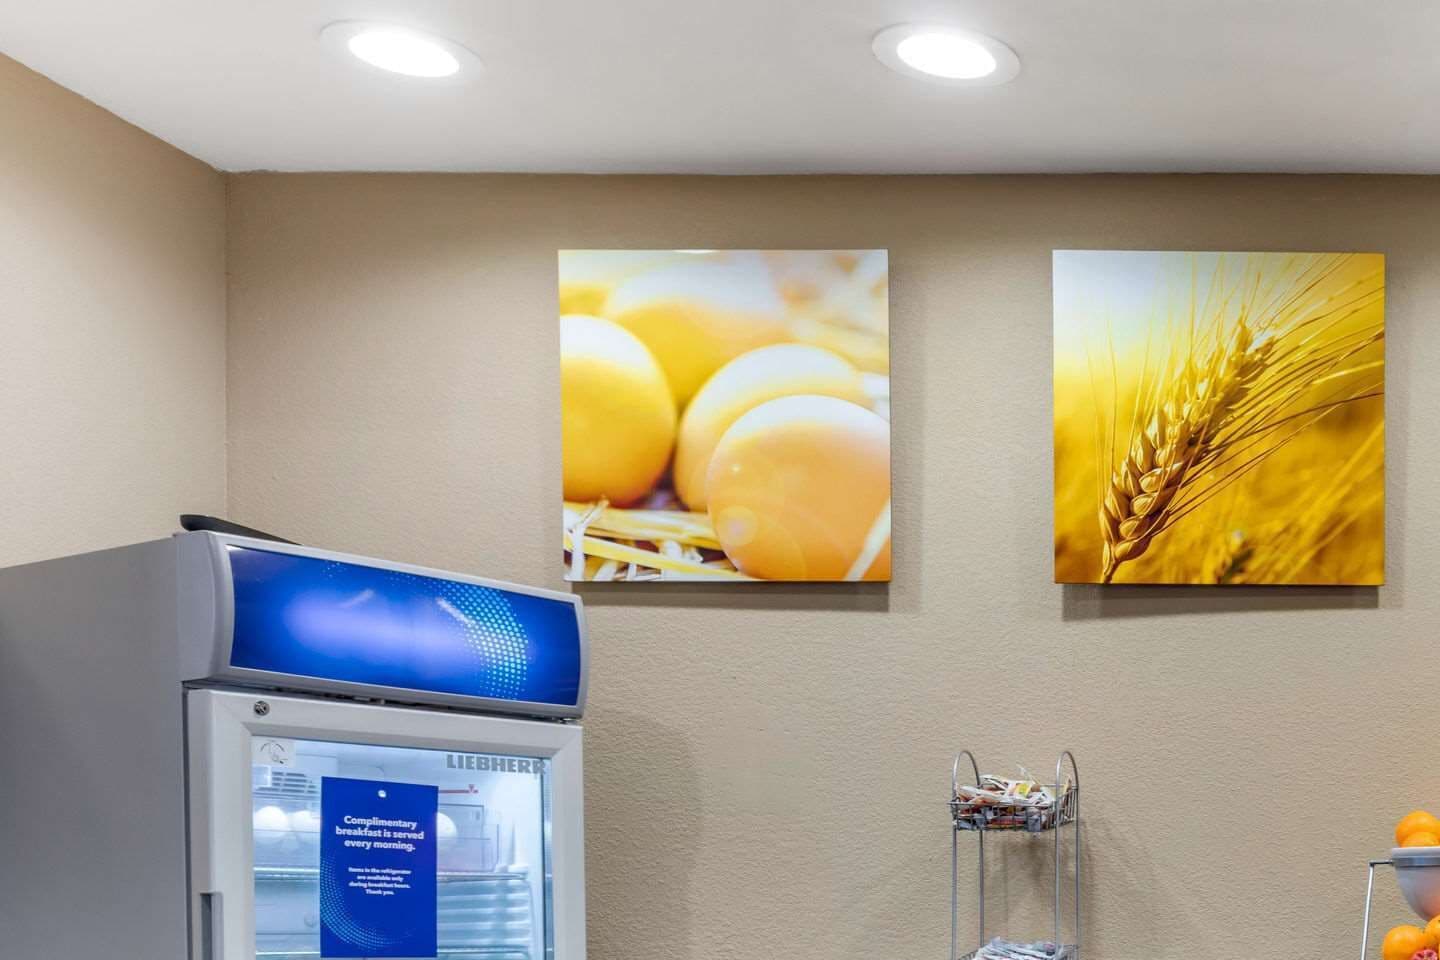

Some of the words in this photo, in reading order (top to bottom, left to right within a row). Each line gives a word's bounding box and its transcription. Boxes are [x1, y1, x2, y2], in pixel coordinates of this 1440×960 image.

[446, 754, 546, 774] LIEBHERR
[344, 815, 418, 830] Complimentary
[335, 825, 382, 837] breakfast
[383, 829, 392, 838] is
[393, 831, 425, 840] served
[344, 839, 372, 850] every
[373, 840, 416, 852] morning.
